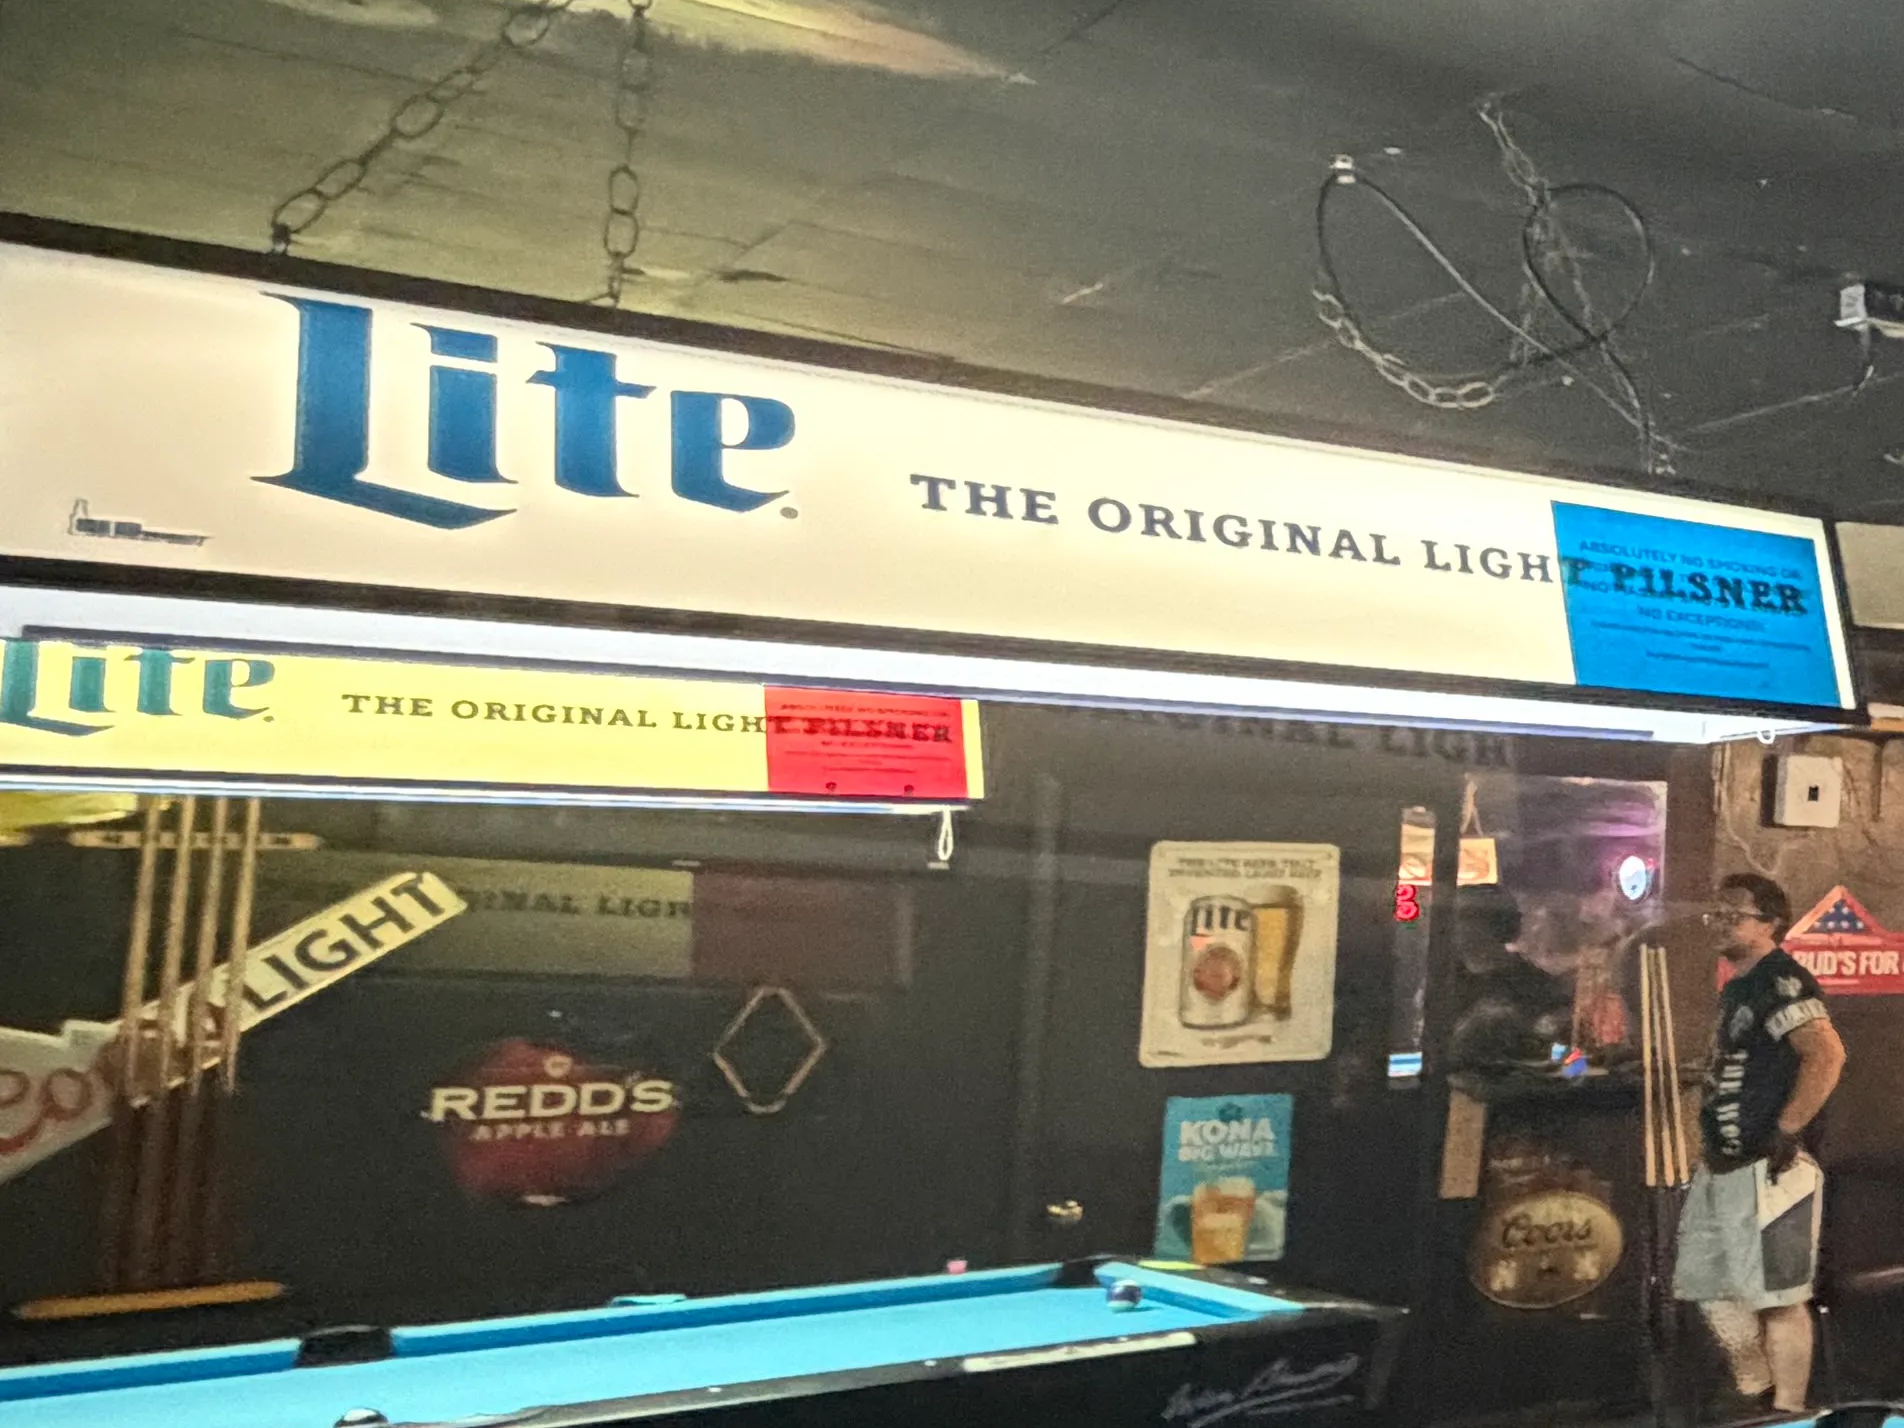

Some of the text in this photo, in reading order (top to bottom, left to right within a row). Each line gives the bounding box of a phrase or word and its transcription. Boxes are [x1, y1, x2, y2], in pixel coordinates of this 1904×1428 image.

[250, 291, 797, 530] Lite
[909, 474, 1059, 527] THE
[1087, 496, 1400, 566] ORIGINAL
[1421, 536, 1591, 586] LIGHT
[1609, 563, 1808, 616] PILSNER
[0, 639, 275, 736] Lite
[342, 693, 953, 743] THE ORIGINAL LIGHT PILSNER
[242, 872, 445, 1011] LIGHT
[1859, 950, 1900, 977] FOR
[1180, 1118, 1276, 1146] KONA
